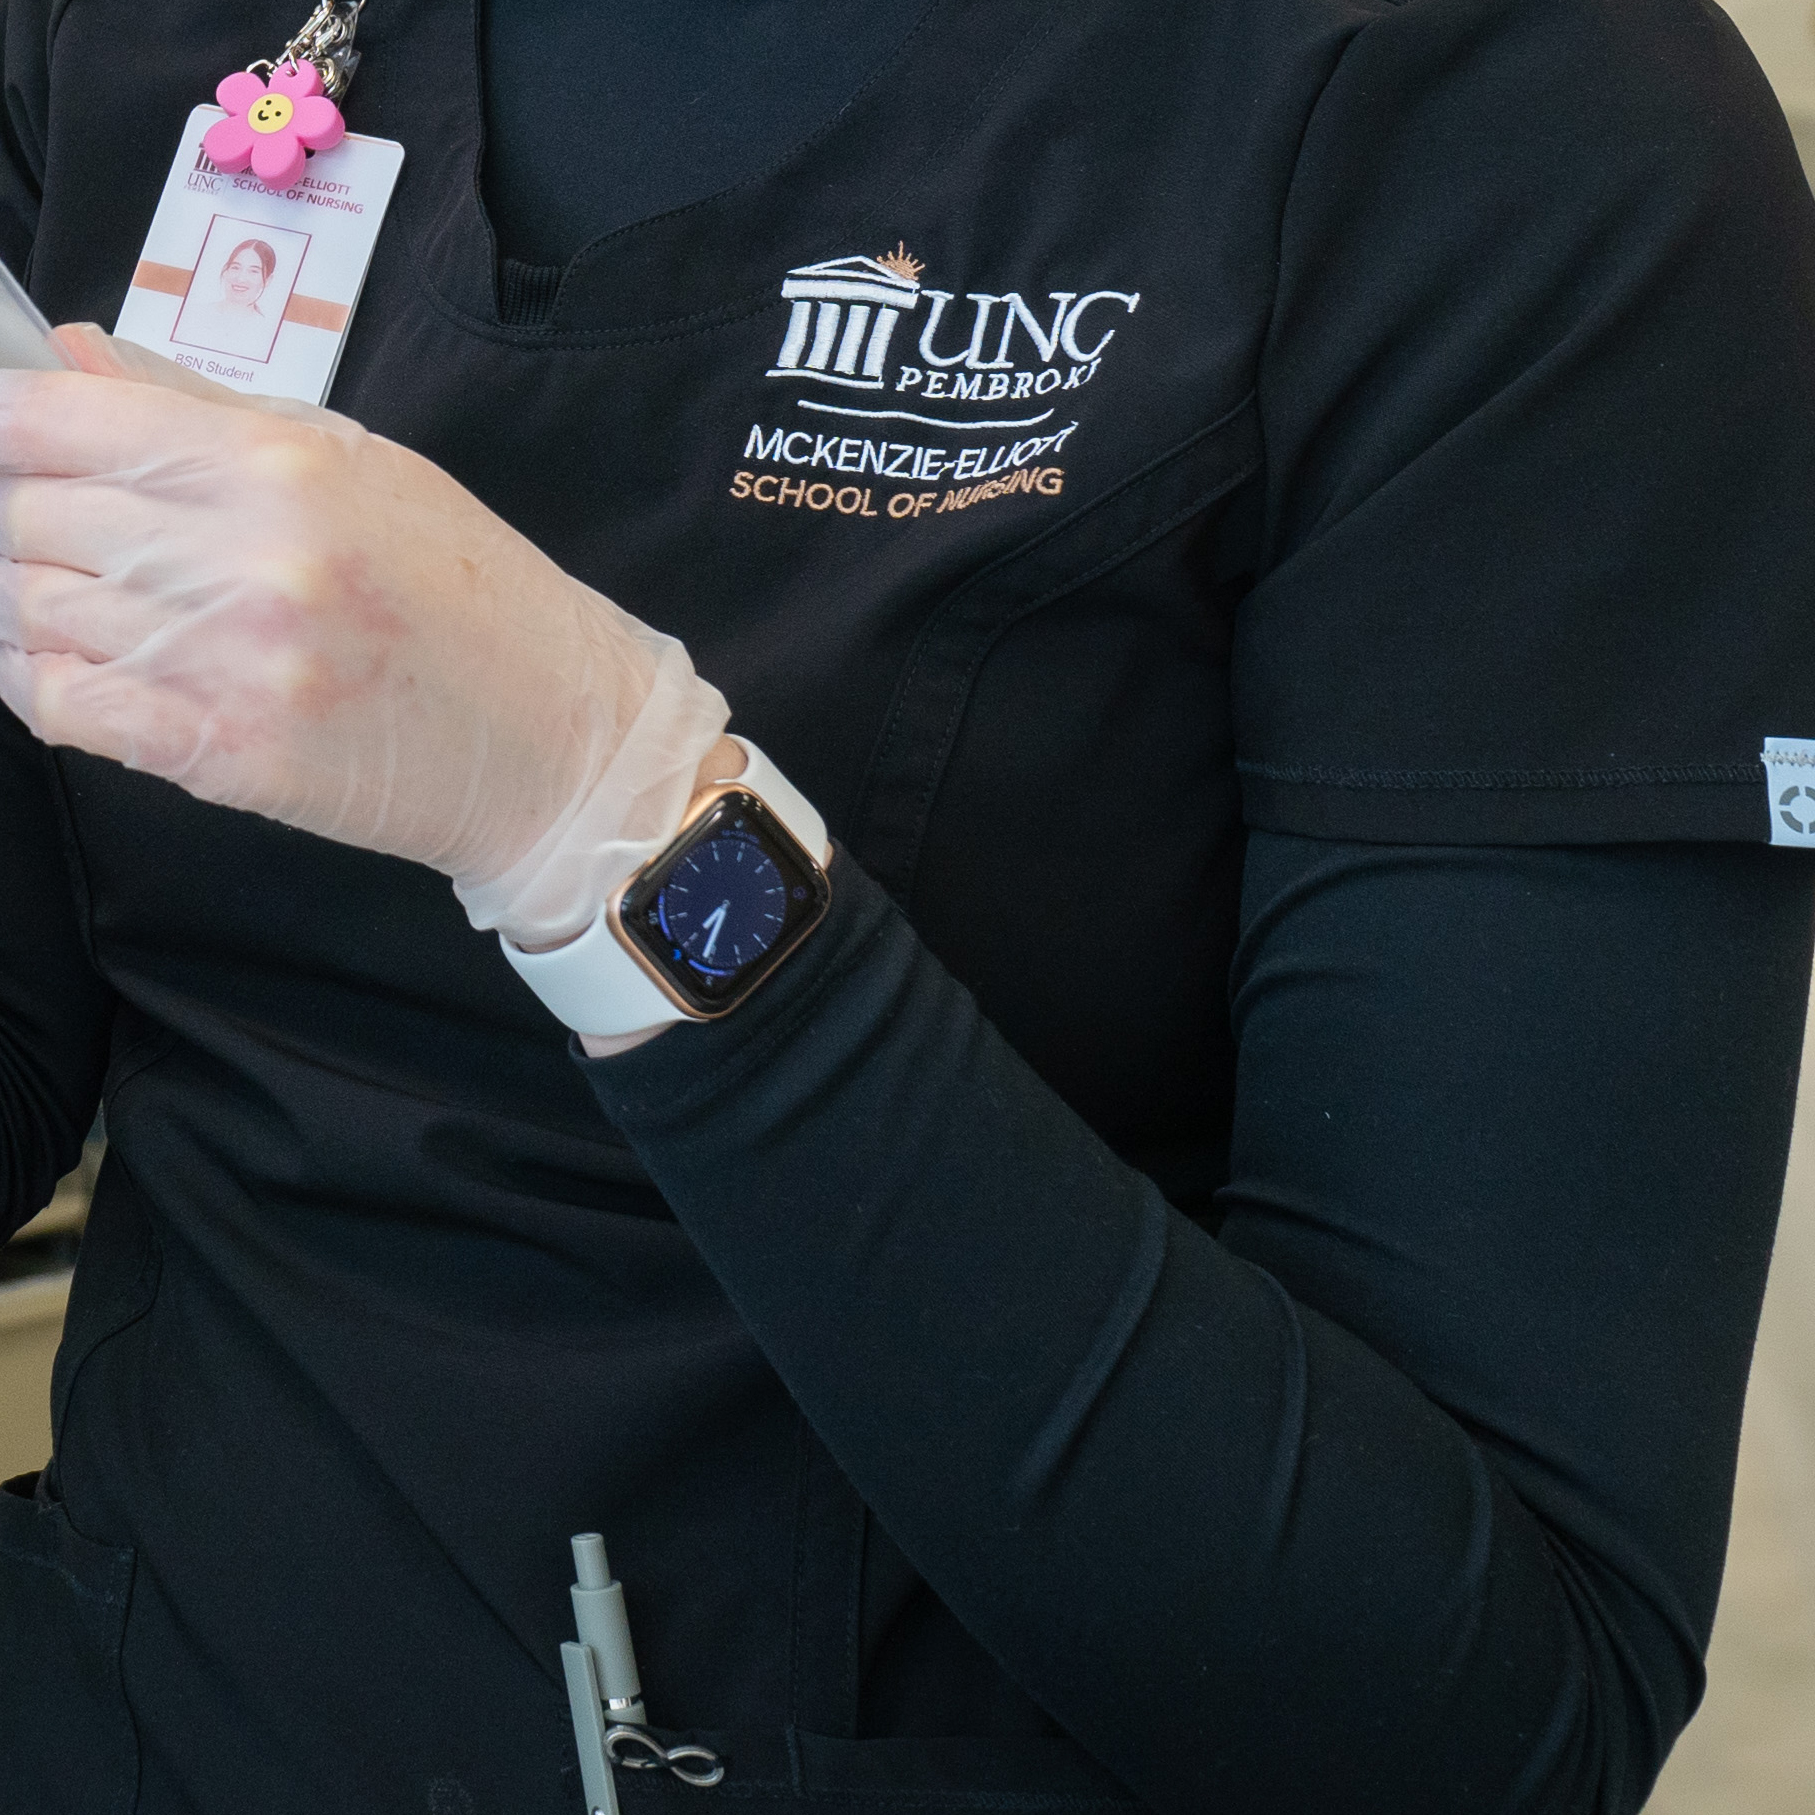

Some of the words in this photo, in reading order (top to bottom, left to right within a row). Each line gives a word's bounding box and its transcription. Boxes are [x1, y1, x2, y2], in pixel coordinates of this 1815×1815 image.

[187, 172, 224, 192] UNC
[286, 189, 305, 201] OF
[306, 193, 364, 215] NURSING
[920, 288, 1141, 370] UNC
[174, 353, 203, 371] BSN
[206, 360, 255, 383] Student
[743, 420, 1079, 481] MCKENZIE-ELLIOTT
[729, 470, 878, 518] SCHOOL
[887, 491, 938, 519] OF
[936, 466, 1066, 514] NURSING
